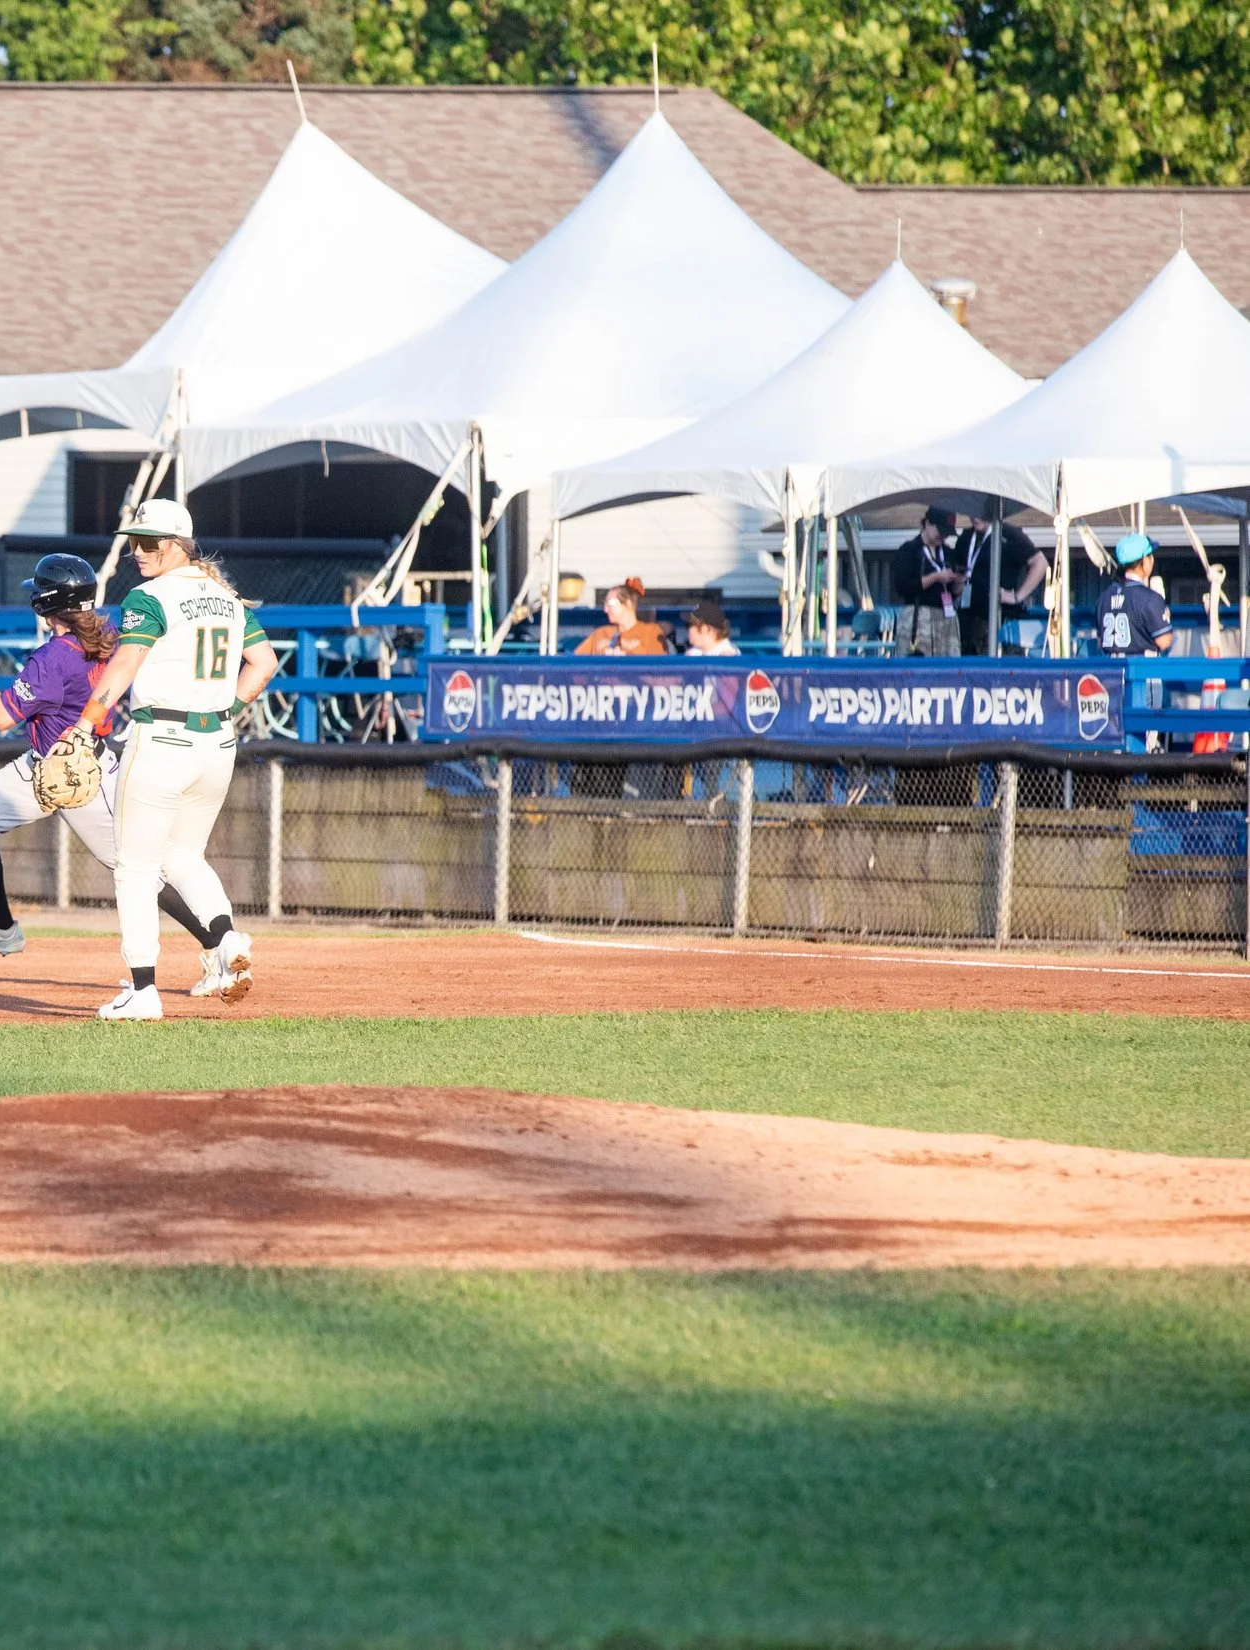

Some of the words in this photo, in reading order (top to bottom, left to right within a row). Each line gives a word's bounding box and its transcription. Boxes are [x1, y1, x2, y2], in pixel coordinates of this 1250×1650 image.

[179, 597, 235, 621] SCHRODER
[1102, 612, 1131, 648] 29
[194, 627, 230, 680] 16
[502, 684, 568, 721] PEPSI
[569, 684, 649, 721] PARTY
[652, 684, 715, 721] DECK
[749, 695, 778, 707] PEPSI
[808, 687, 881, 724] PEPSI
[882, 687, 966, 725] PARTY
[972, 687, 1044, 726] DECK
